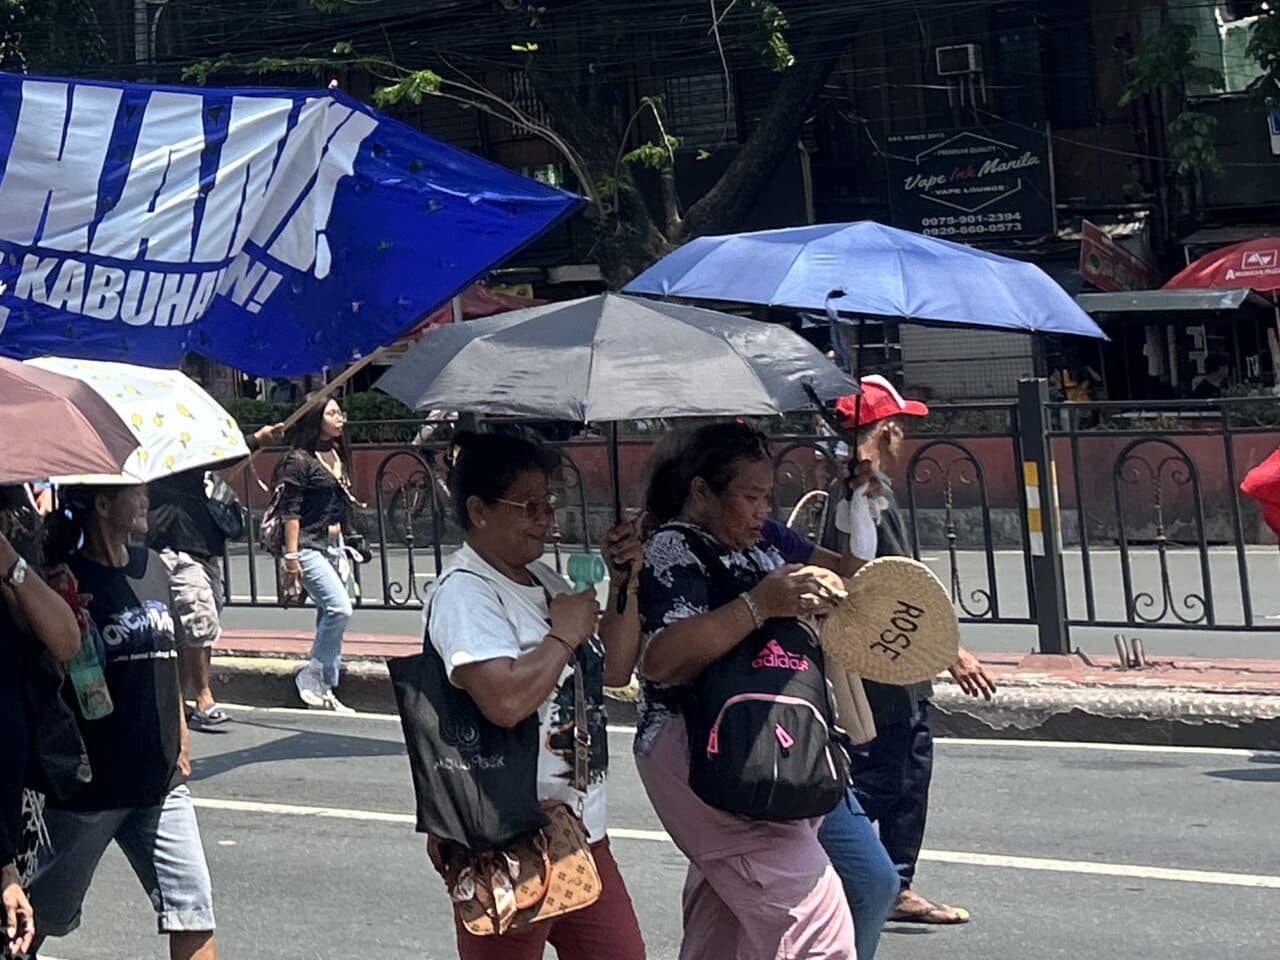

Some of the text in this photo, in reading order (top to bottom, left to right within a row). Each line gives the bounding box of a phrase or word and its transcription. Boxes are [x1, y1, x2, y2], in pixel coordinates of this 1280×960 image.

[904, 174, 947, 191] Vape
[977, 151, 1041, 178] Manila
[869, 599, 925, 662] ROSE
[751, 649, 810, 672] adidas
